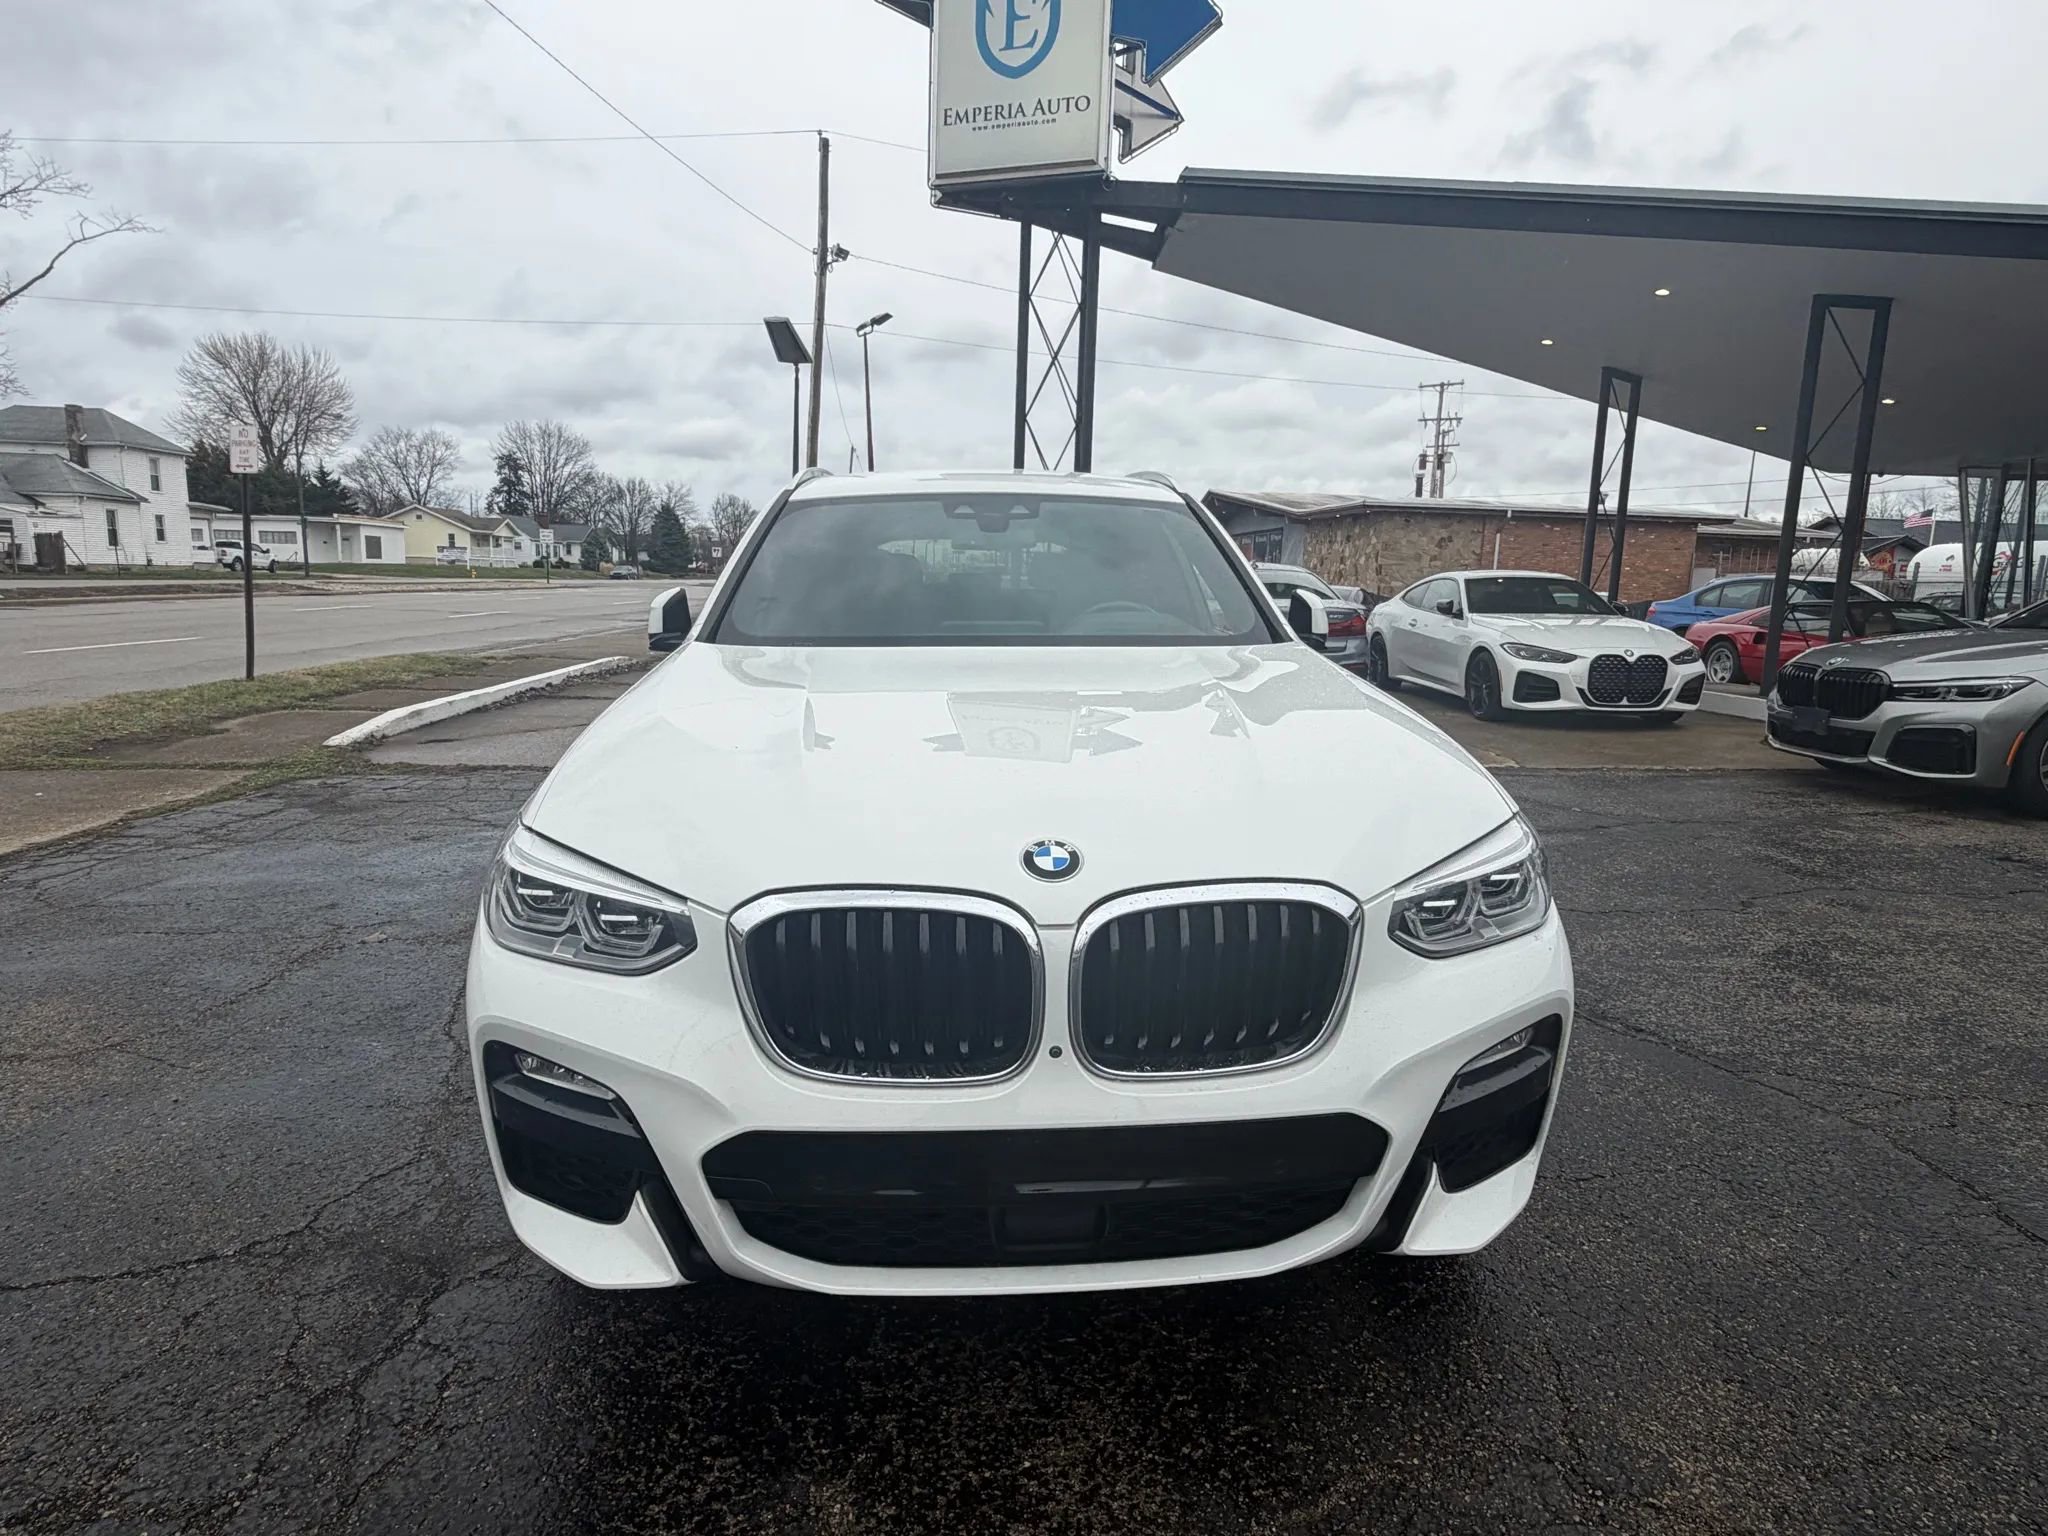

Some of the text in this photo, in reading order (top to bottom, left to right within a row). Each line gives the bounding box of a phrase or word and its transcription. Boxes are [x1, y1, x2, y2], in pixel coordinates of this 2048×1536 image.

[943, 95, 1091, 126] EMPERIA AUTO
[972, 117, 1057, 131] www.emperiaauto.com
[239, 429, 249, 438] NO
[231, 439, 257, 447] PARKING
